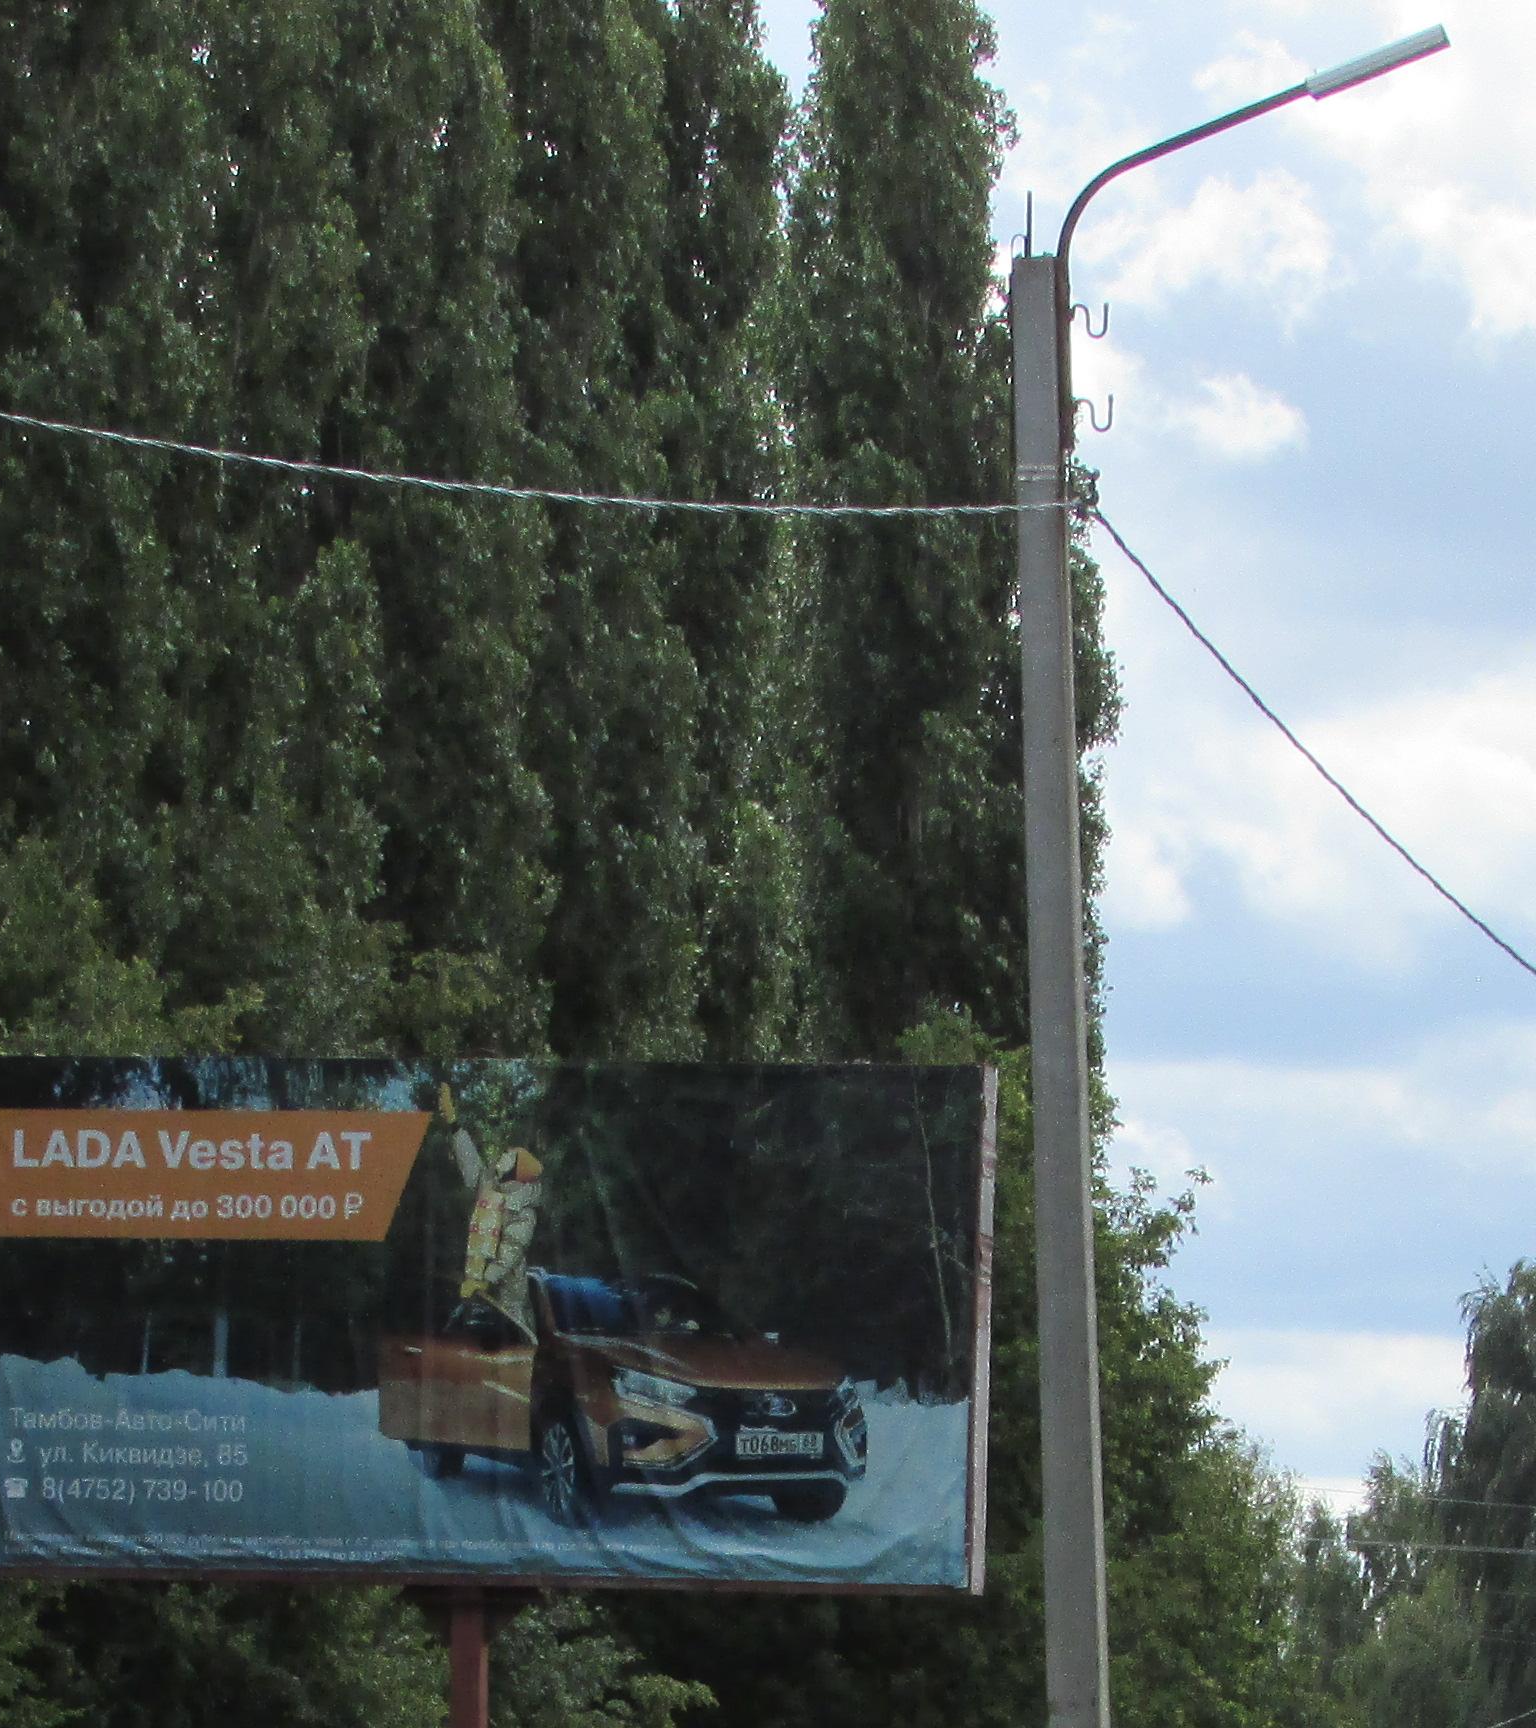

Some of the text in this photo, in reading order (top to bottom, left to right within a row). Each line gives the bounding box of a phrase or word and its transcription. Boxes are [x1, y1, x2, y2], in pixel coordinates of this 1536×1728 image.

[13, 1128, 372, 1170] LADA Vesta AT
[11, 1199, 27, 1216] с
[36, 1194, 163, 1221] выгодой
[170, 1199, 209, 1220] до
[216, 1194, 272, 1218] 300
[280, 1195, 336, 1219] 000
[9, 1407, 246, 1433] Тамбов-Авто-Сити
[39, 1440, 248, 1469] ул. Киквидзе, 85
[42, 1477, 243, 1504] 8(4752) 739-100
